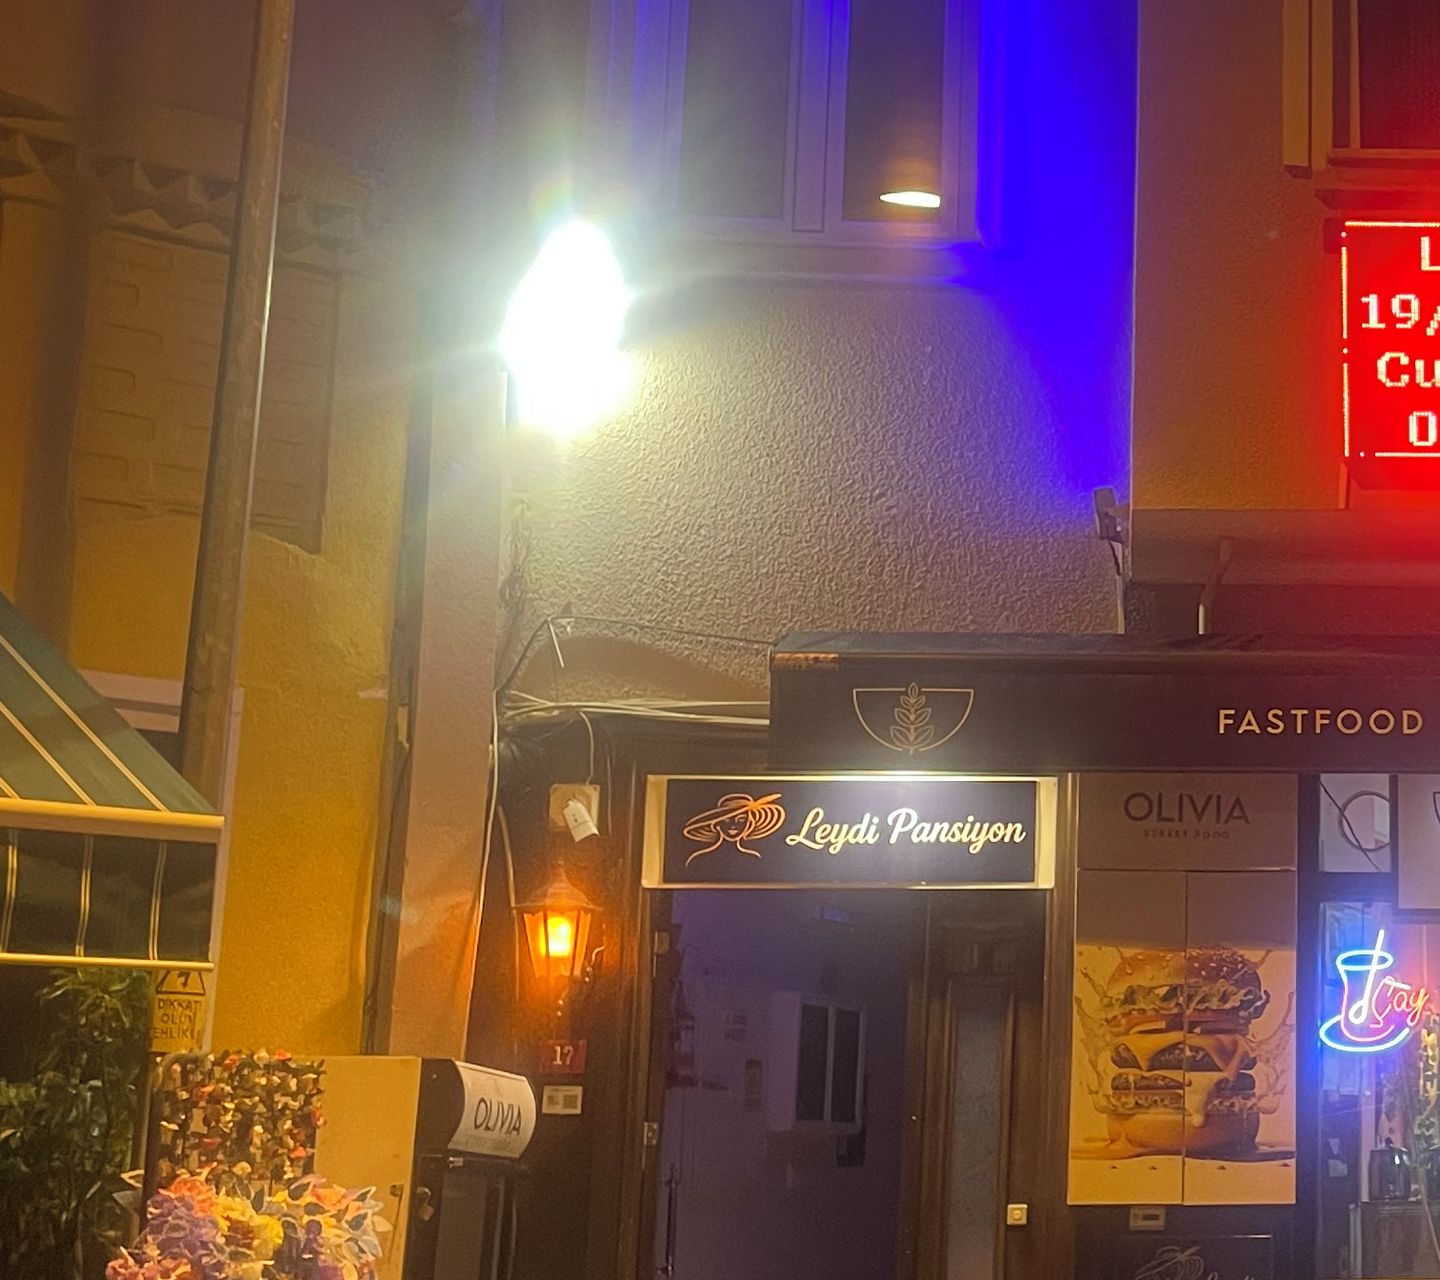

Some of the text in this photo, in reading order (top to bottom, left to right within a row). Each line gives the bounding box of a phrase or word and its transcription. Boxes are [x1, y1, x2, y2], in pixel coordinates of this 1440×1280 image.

[1218, 708, 1424, 735] FASTFOOD
[1123, 791, 1250, 825] OLIVIA
[785, 806, 1027, 855] Leydi Pansiyon
[552, 1045, 574, 1066] 17
[473, 1096, 523, 1137] OLIVIA
